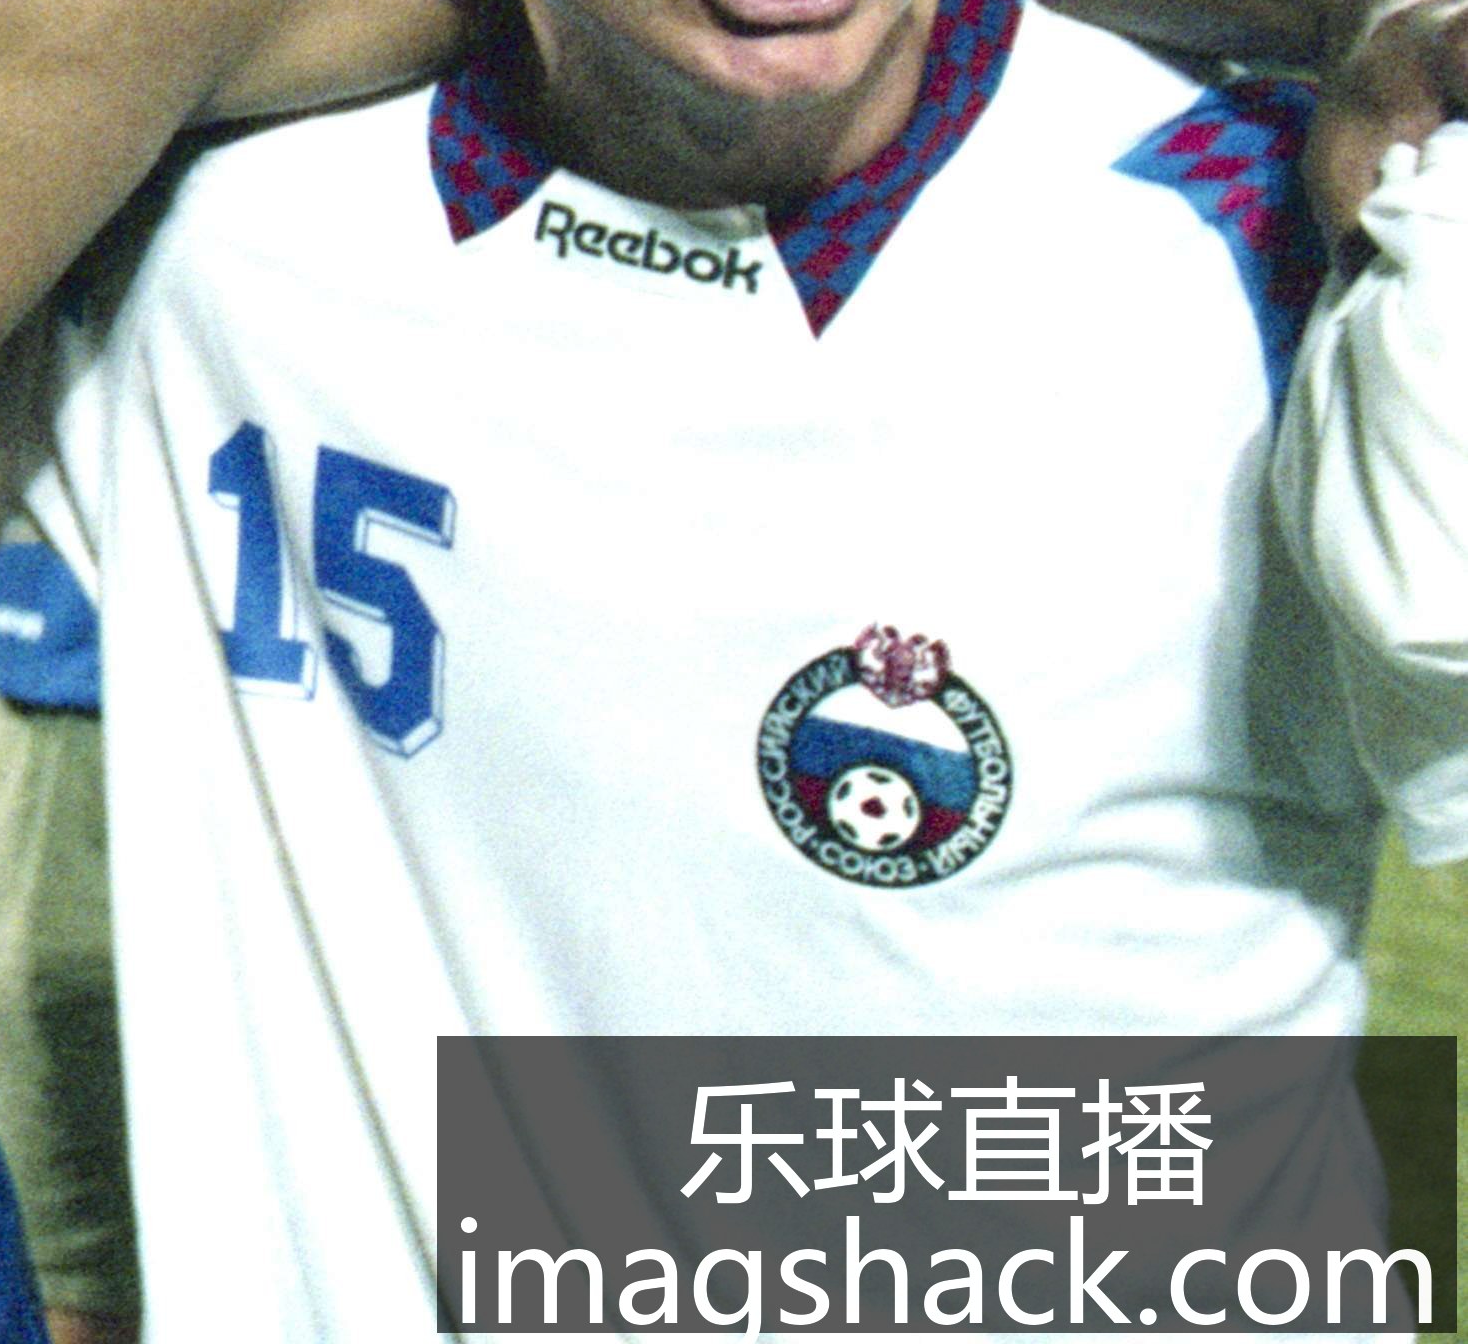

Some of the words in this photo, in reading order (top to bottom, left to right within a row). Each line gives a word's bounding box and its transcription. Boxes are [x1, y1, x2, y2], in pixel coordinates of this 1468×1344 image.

[535, 201, 763, 294] Reebok
[209, 420, 457, 761] 15
[819, 840, 919, 883] СОЮЗ
